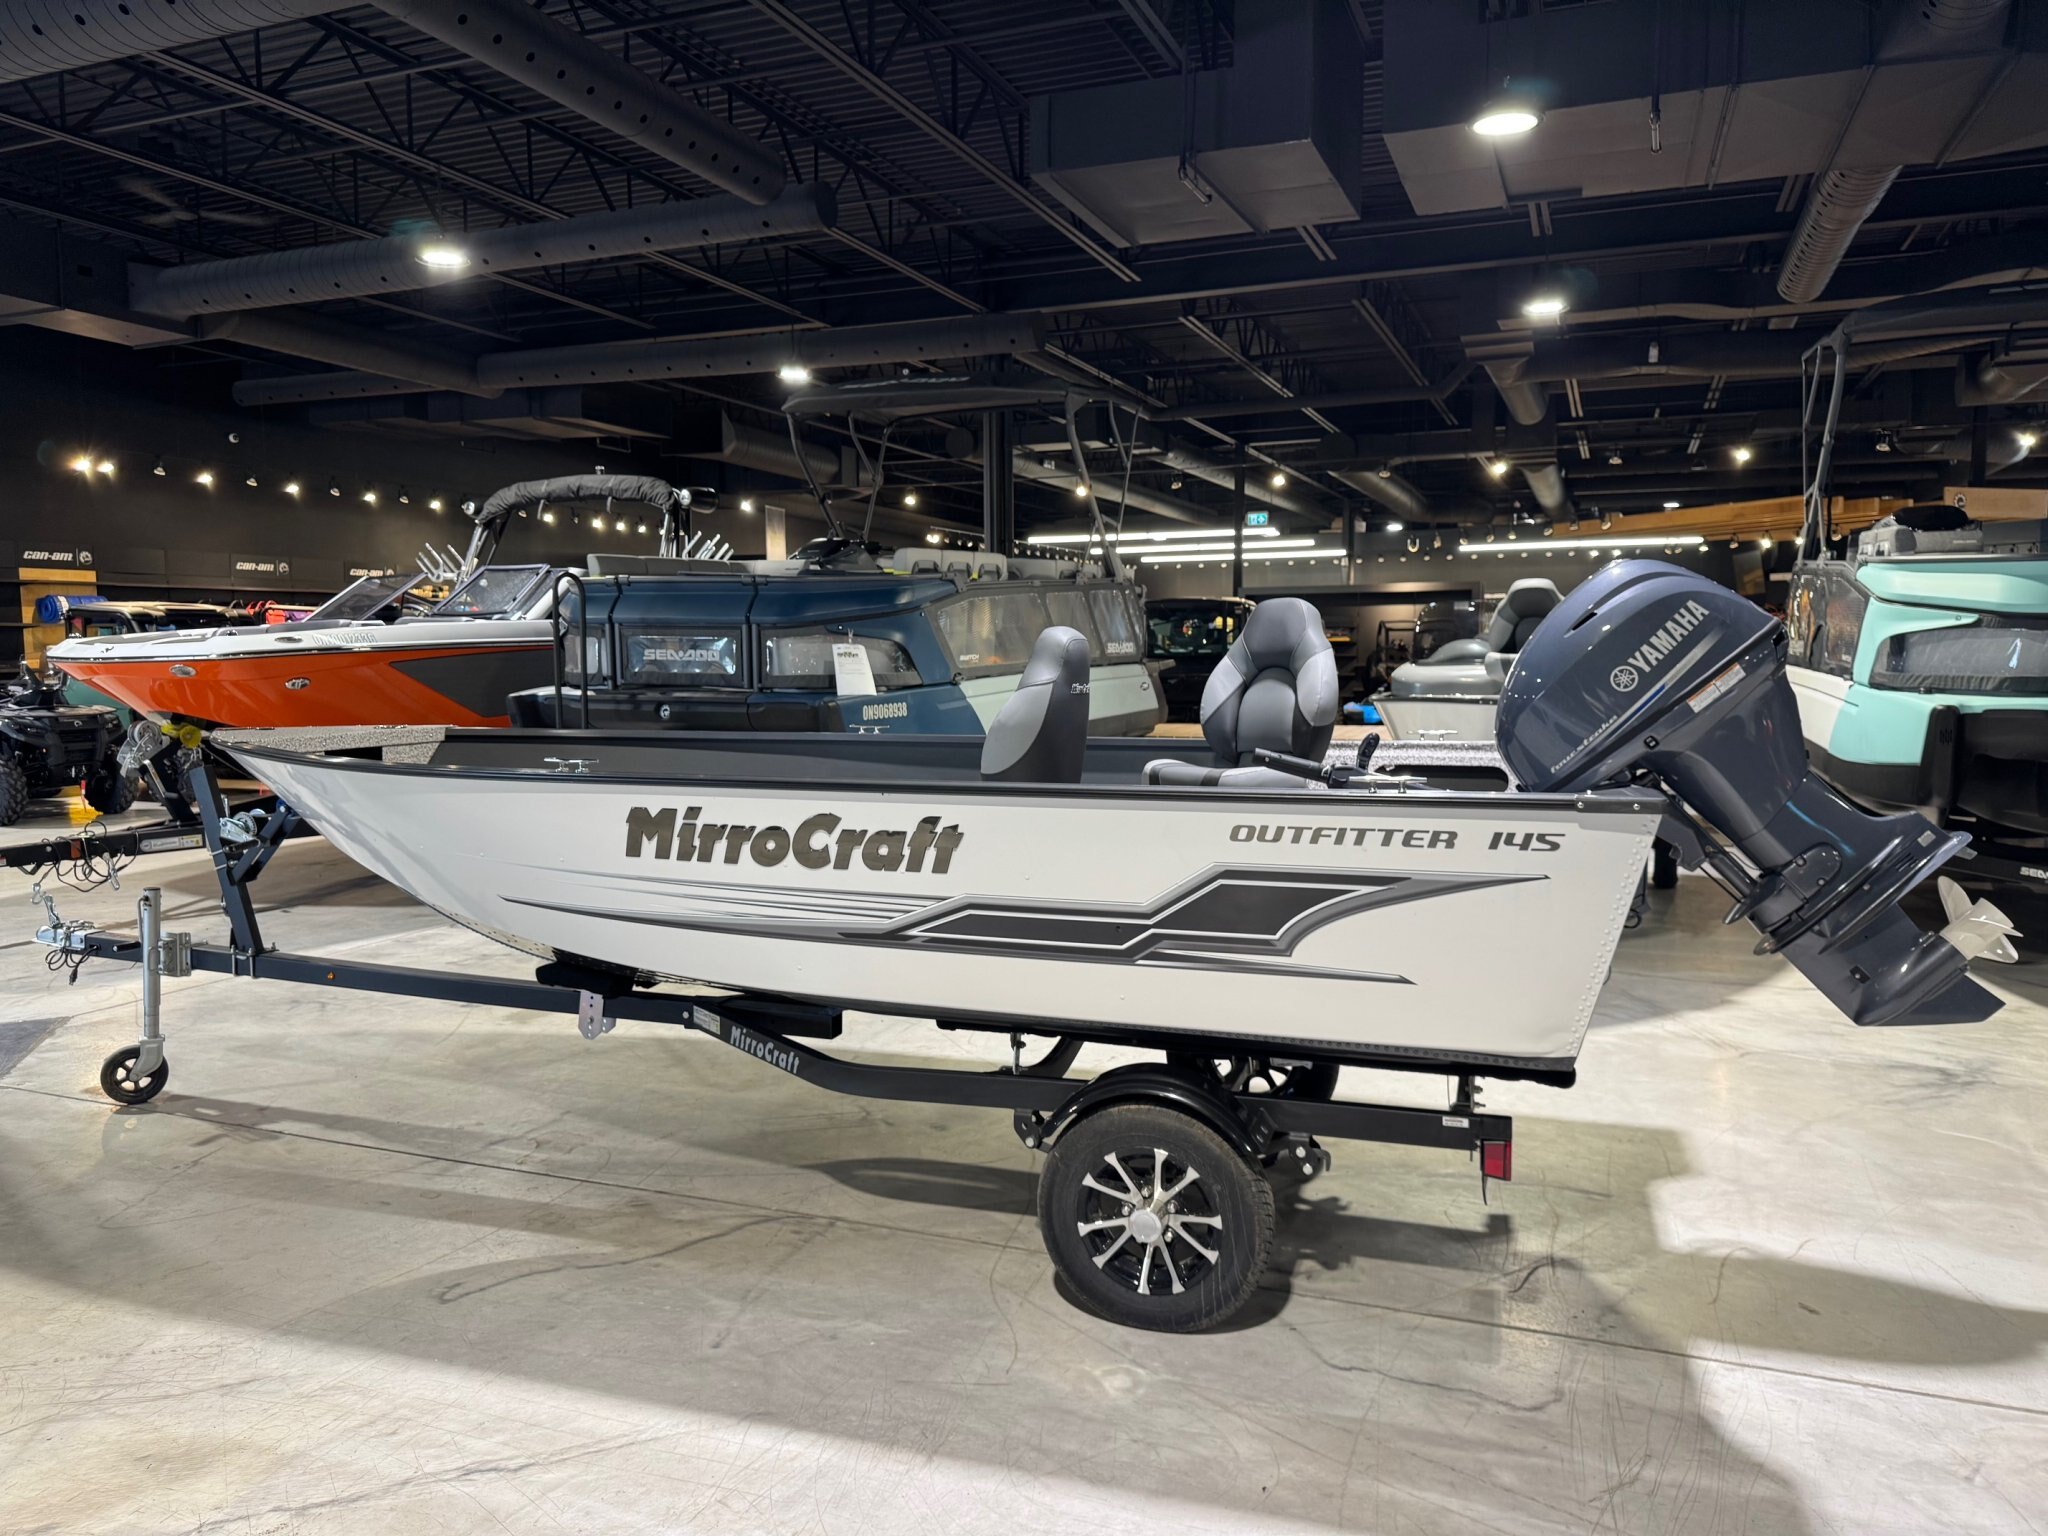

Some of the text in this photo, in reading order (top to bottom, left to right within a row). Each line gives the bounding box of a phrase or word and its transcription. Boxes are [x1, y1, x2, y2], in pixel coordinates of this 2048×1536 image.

[23, 550, 73, 561] can-am
[236, 562, 275, 572] can-am
[1627, 600, 1710, 673] YAMAHA
[863, 702, 908, 720] ON9068938
[625, 806, 964, 874] MirroCraft
[1229, 824, 1565, 852] OUTFITTER 145
[730, 1025, 799, 1074] MirroCraft
